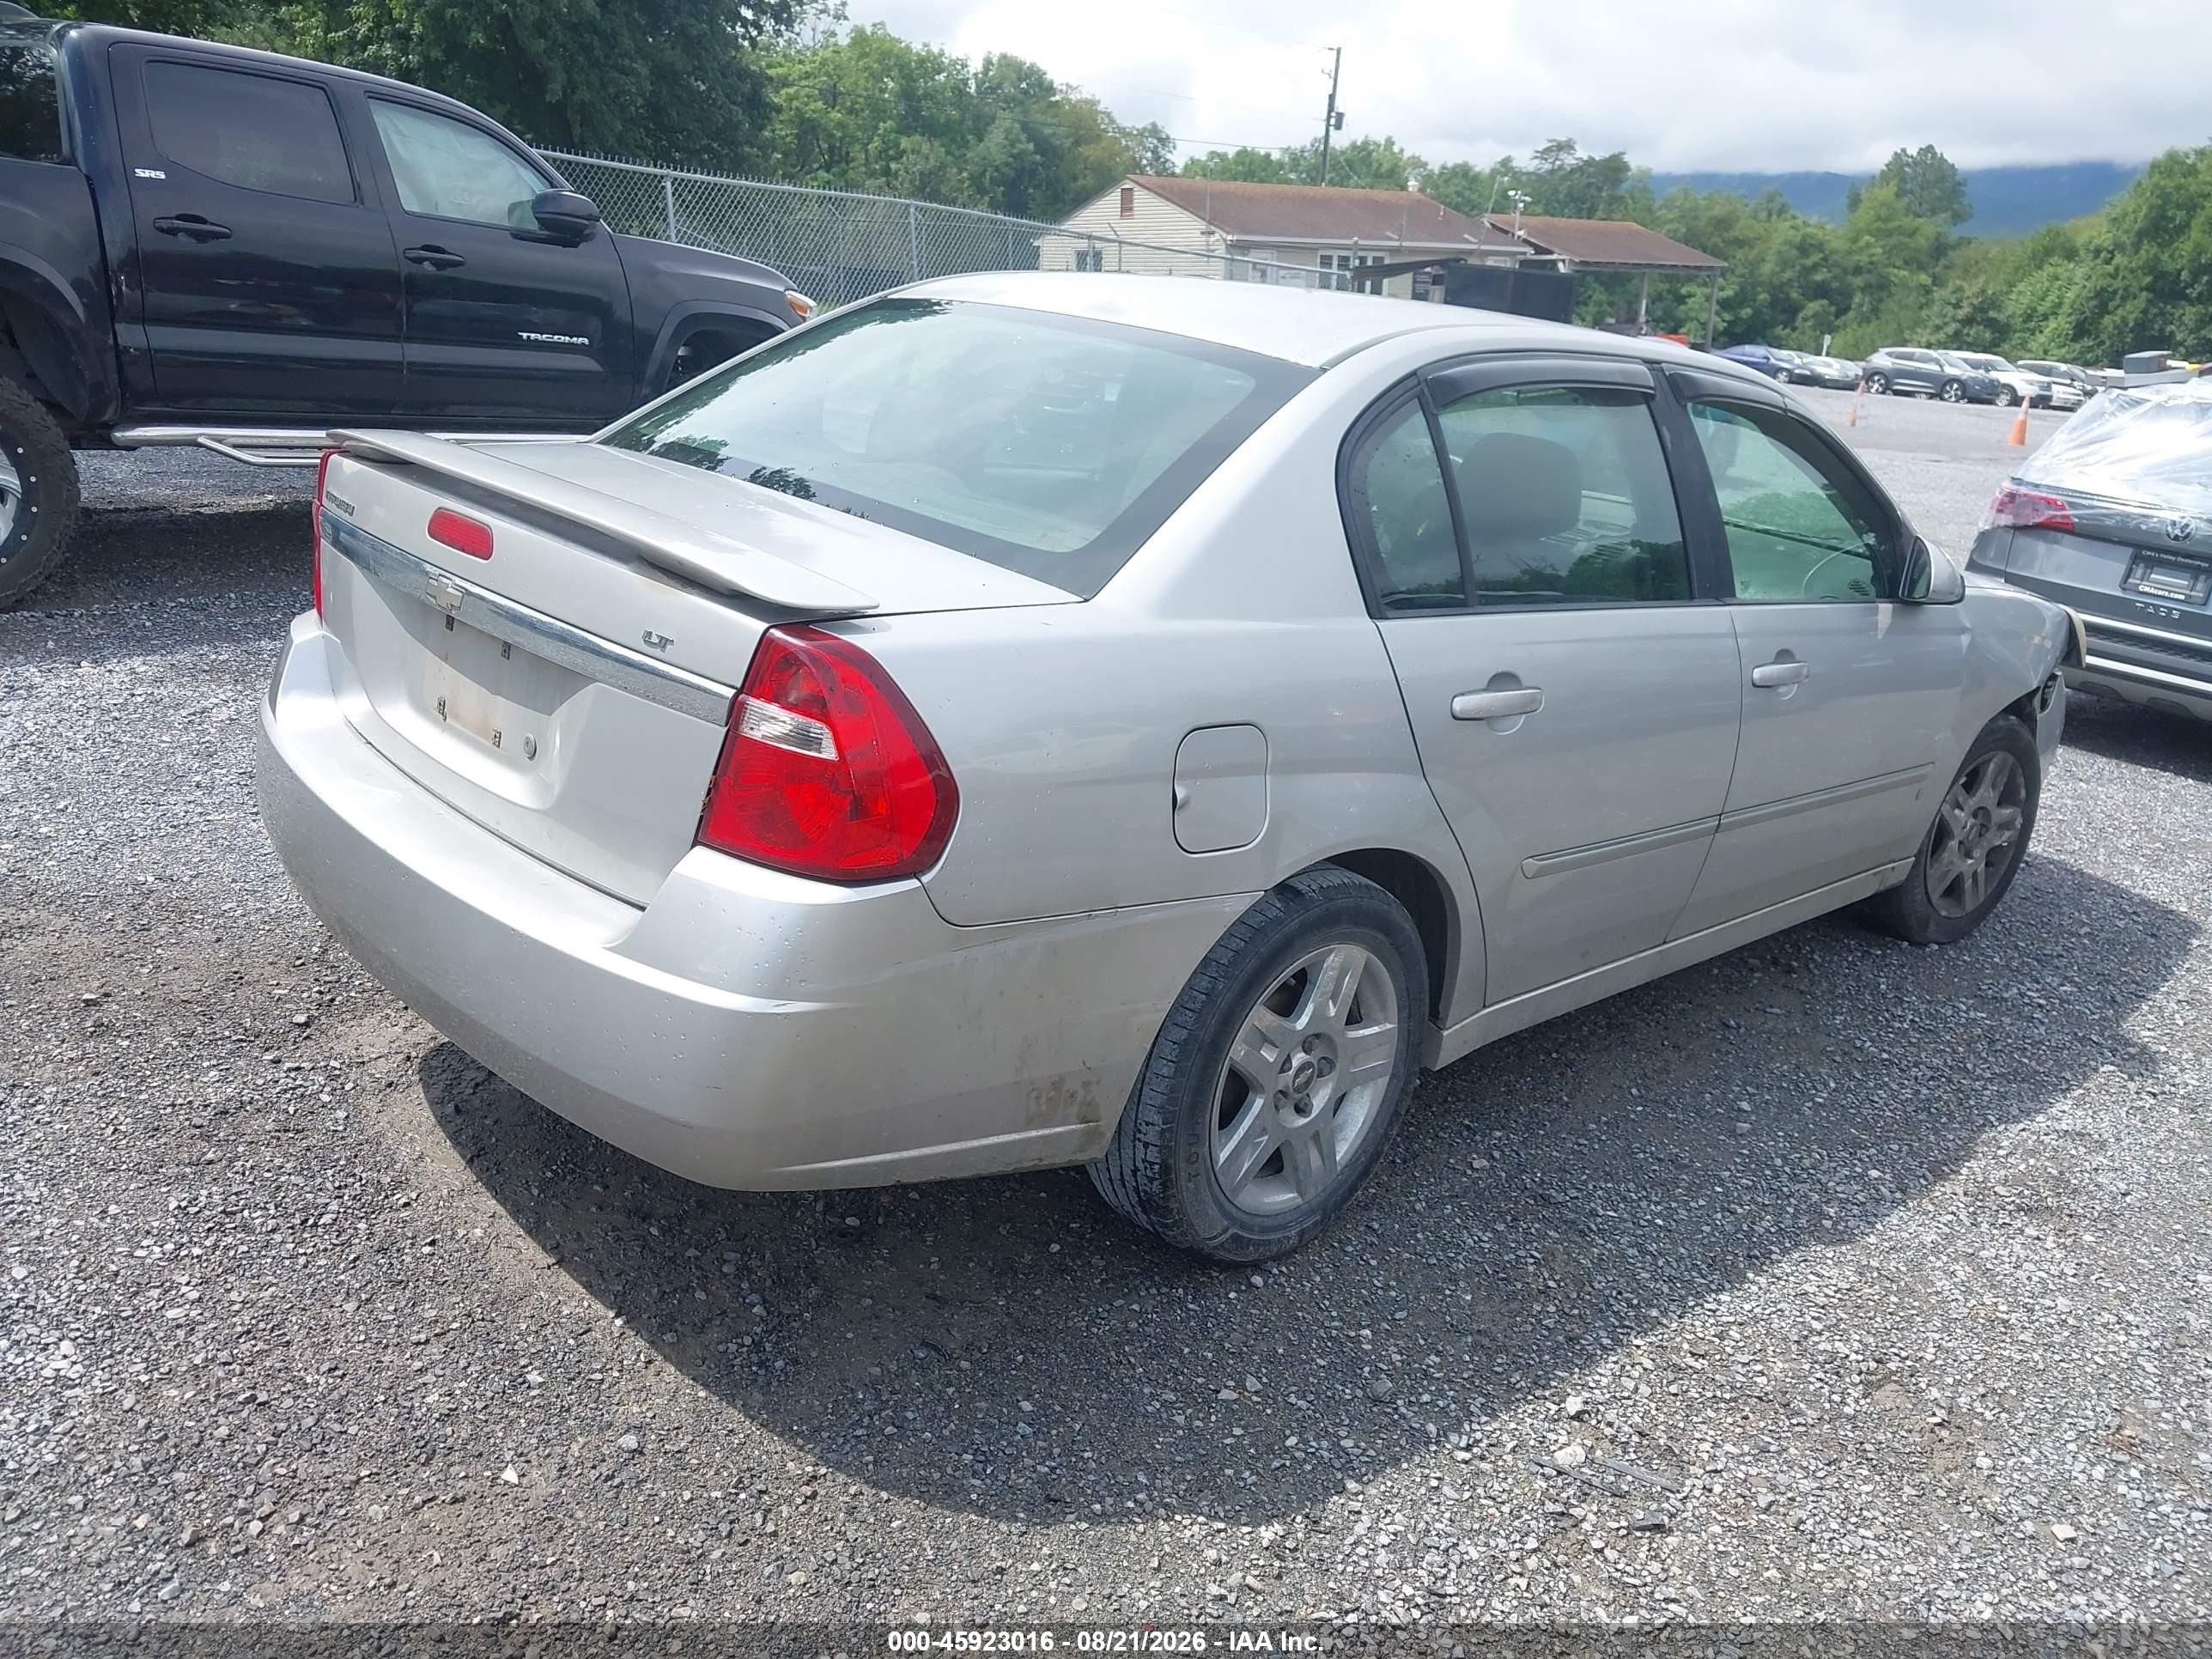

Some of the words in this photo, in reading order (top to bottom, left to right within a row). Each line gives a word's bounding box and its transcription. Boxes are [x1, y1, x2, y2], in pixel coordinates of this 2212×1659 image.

[517, 331, 590, 345] TACOMA
[2138, 585, 2185, 600] CMAcars.com
[642, 629, 675, 653] LT
